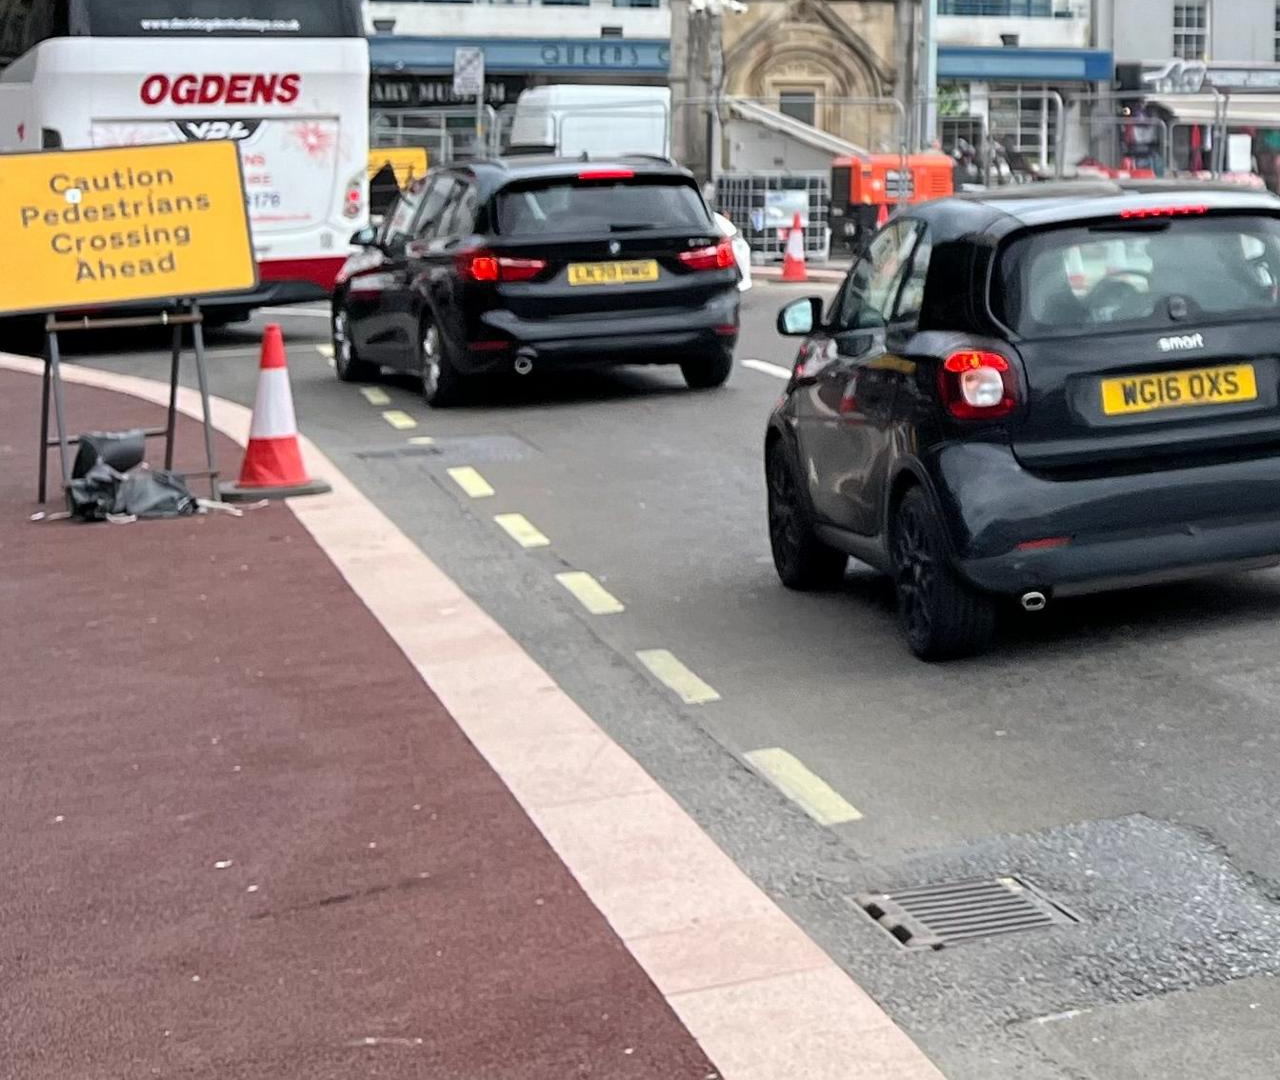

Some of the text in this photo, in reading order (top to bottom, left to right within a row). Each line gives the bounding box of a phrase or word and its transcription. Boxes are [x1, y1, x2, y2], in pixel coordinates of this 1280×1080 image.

[140, 74, 302, 105] OGDENS
[50, 168, 174, 194] Caution
[20, 190, 211, 227] Pedestrians
[51, 224, 191, 254] Crossing
[76, 252, 176, 282] Ahead
[1158, 333, 1204, 352] smart
[1121, 371, 1240, 406] WG16 OXS
